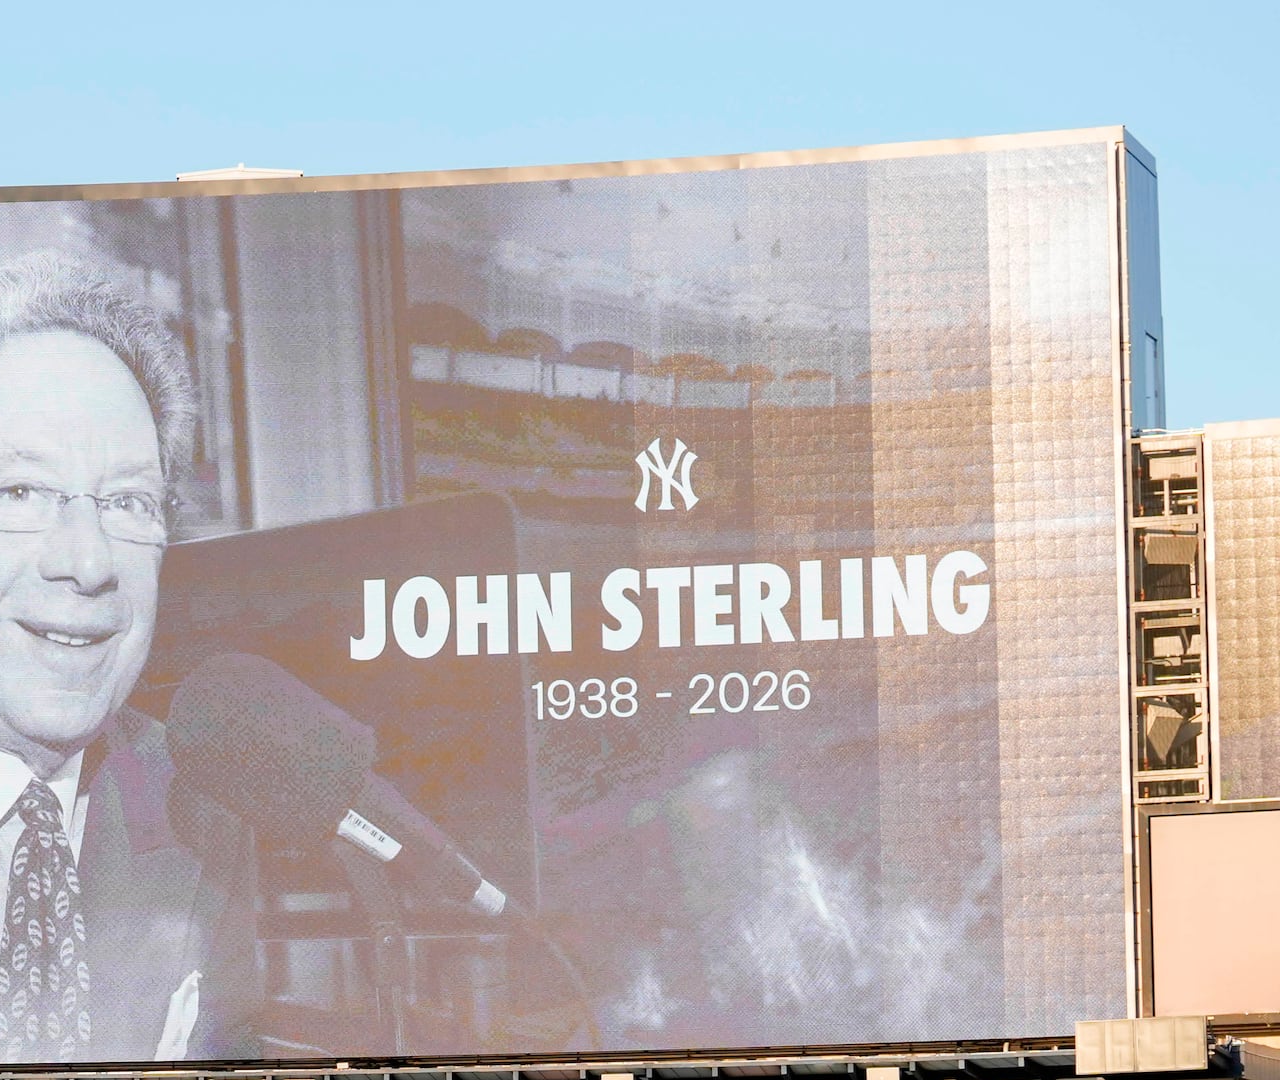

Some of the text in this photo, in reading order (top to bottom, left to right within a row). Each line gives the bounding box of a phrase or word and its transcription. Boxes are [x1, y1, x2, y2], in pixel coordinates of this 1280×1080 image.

[350, 549, 991, 661] JOHN STERLING
[531, 676, 639, 721] 1938
[688, 668, 812, 715] 2026
